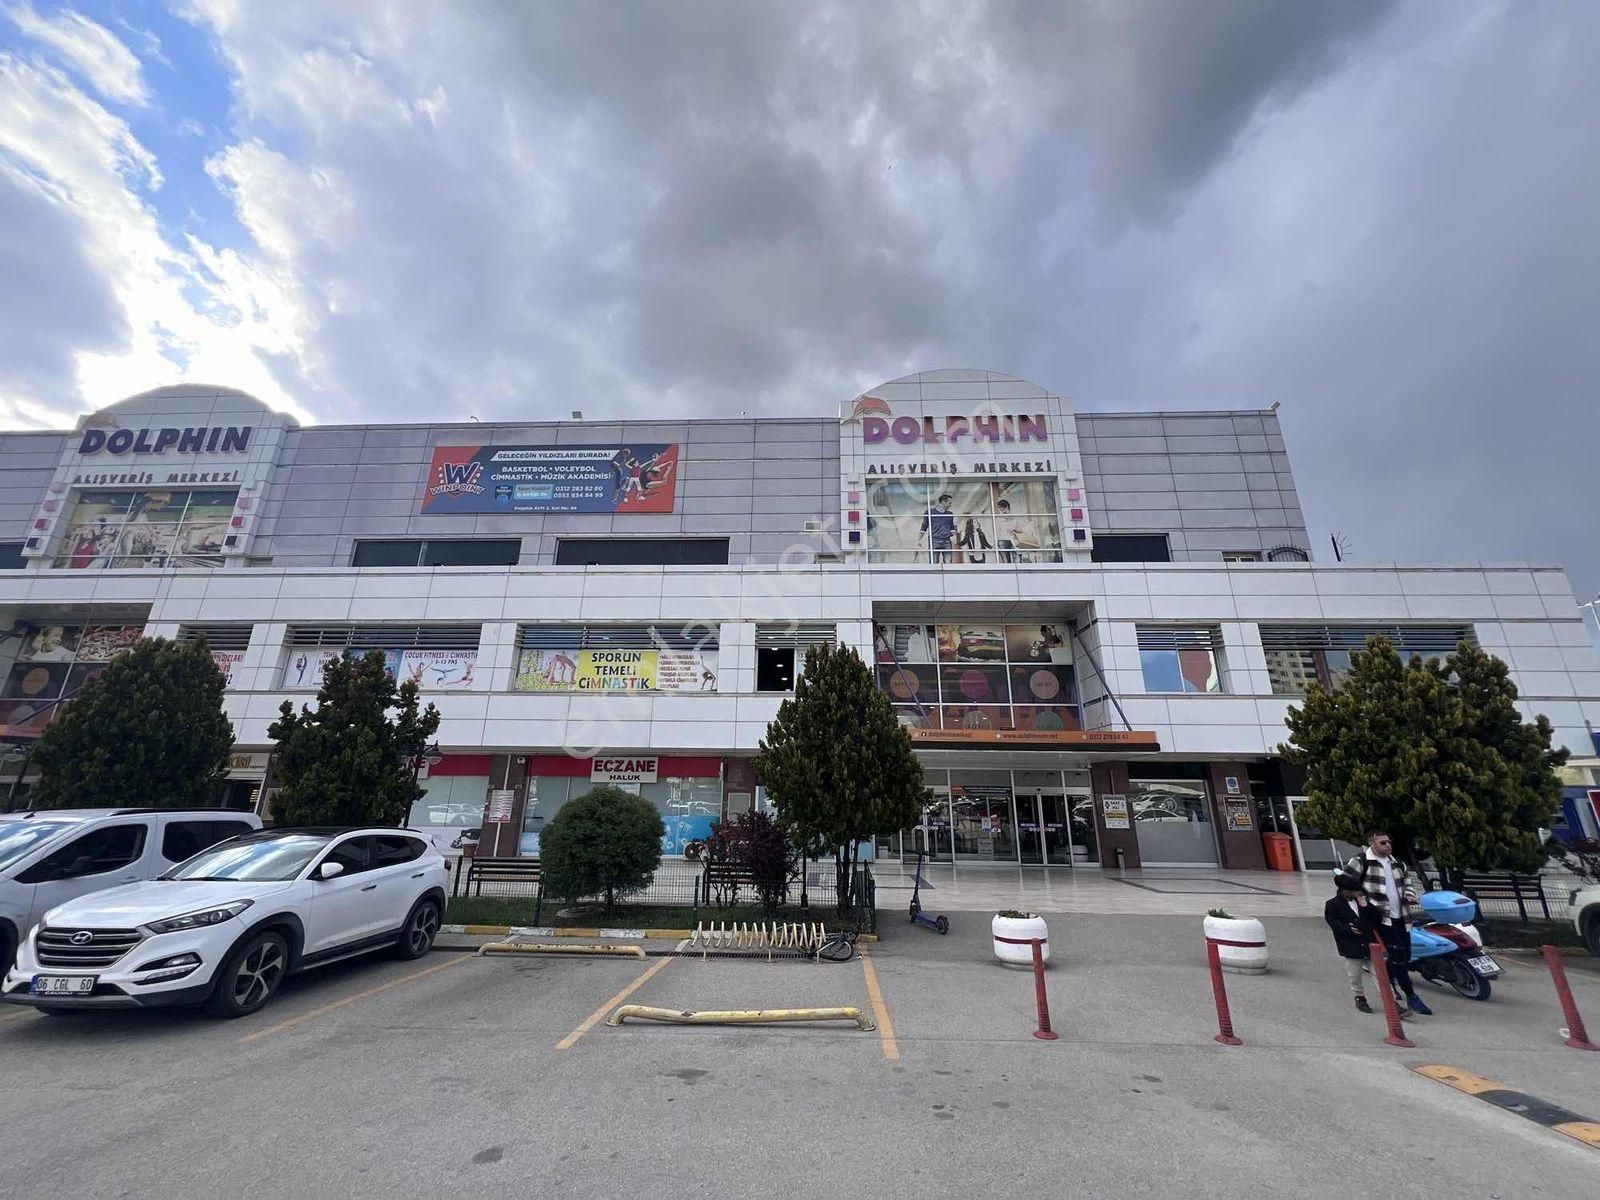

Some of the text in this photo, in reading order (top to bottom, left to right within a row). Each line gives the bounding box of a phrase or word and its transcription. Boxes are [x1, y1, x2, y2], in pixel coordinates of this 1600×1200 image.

[863, 413, 1048, 444] DOLPHIN
[78, 426, 252, 455] DOLPHIN
[973, 459, 1051, 473] MERKEZİ
[166, 471, 238, 482] MERKEZİ
[540, 472, 566, 480] MÜZİK
[591, 652, 641, 662] SPORUN
[594, 760, 656, 772] ECZANE
[36, 979, 93, 990] 06 CGL 60
